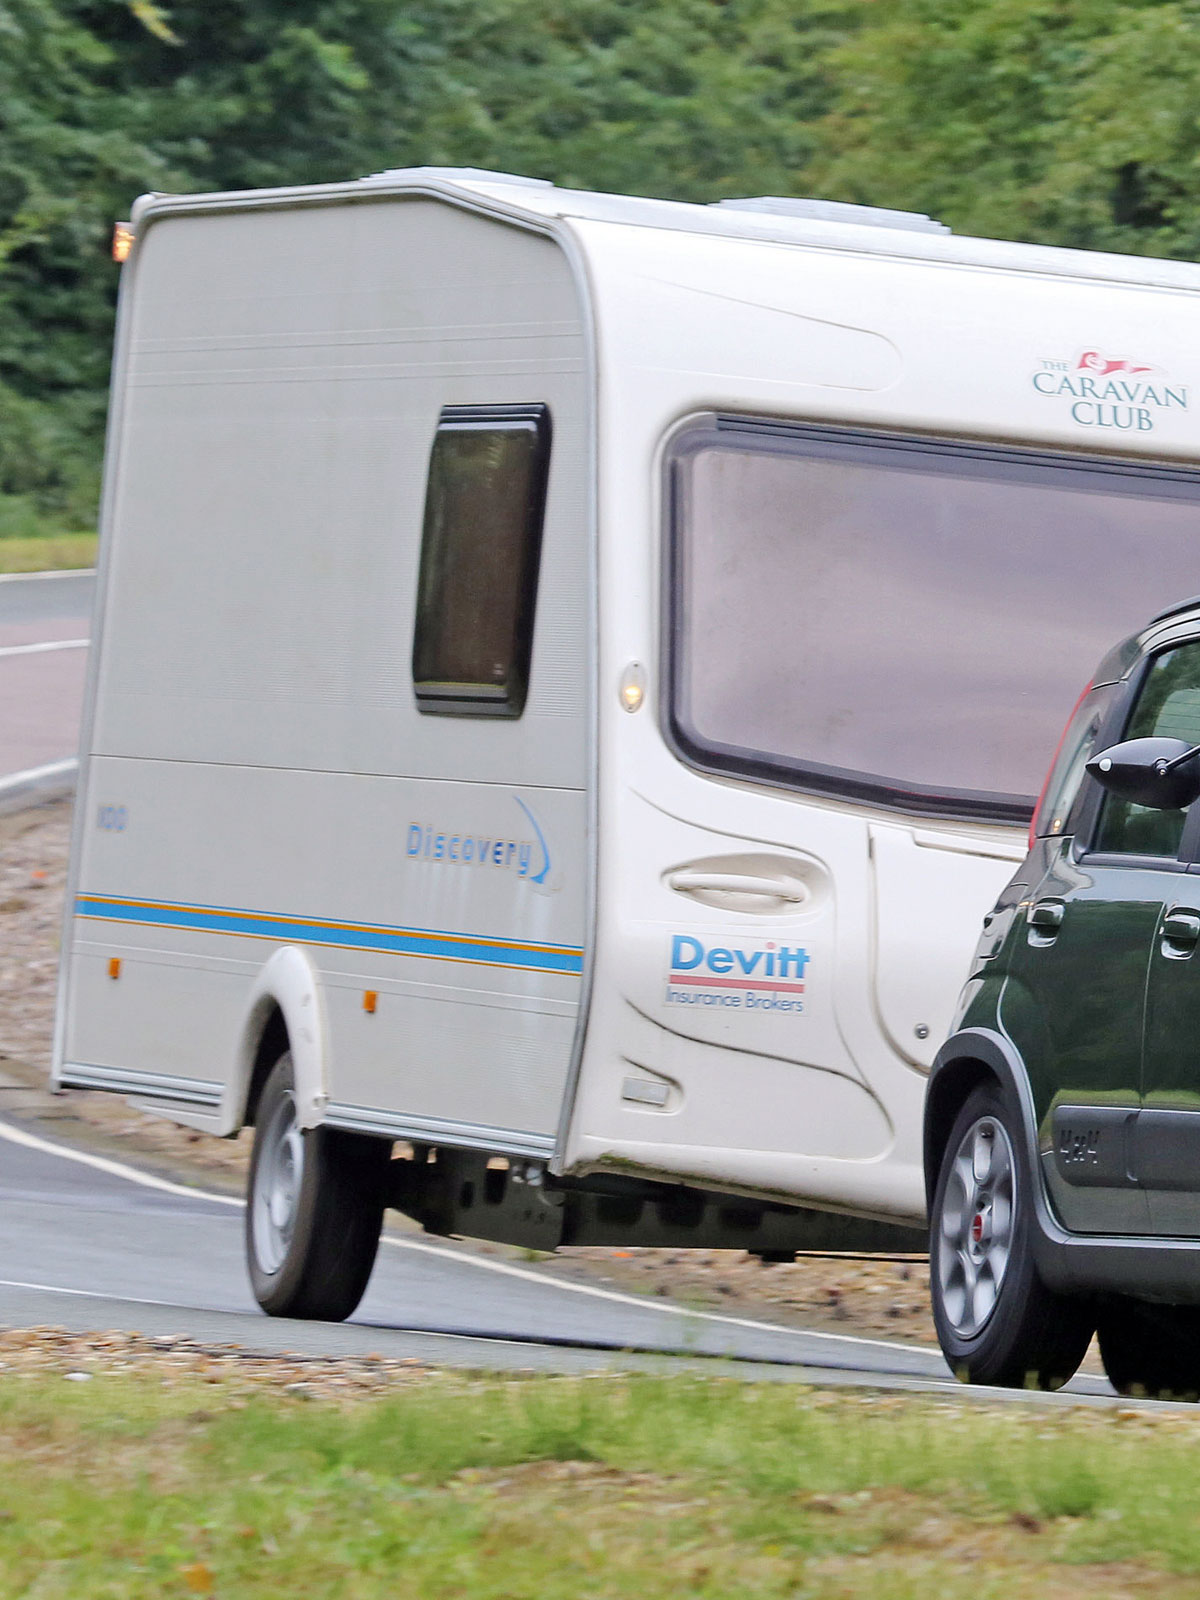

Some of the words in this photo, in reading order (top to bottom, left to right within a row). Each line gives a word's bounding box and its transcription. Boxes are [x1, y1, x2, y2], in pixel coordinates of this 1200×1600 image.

[1042, 360, 1069, 372] THE
[1033, 373, 1187, 408] CARAVAN
[1072, 402, 1153, 431] CLUB
[407, 822, 532, 877] Discovery
[671, 934, 811, 978] Devitt
[666, 985, 740, 1007] Insurance
[745, 991, 803, 1012] Brokers
